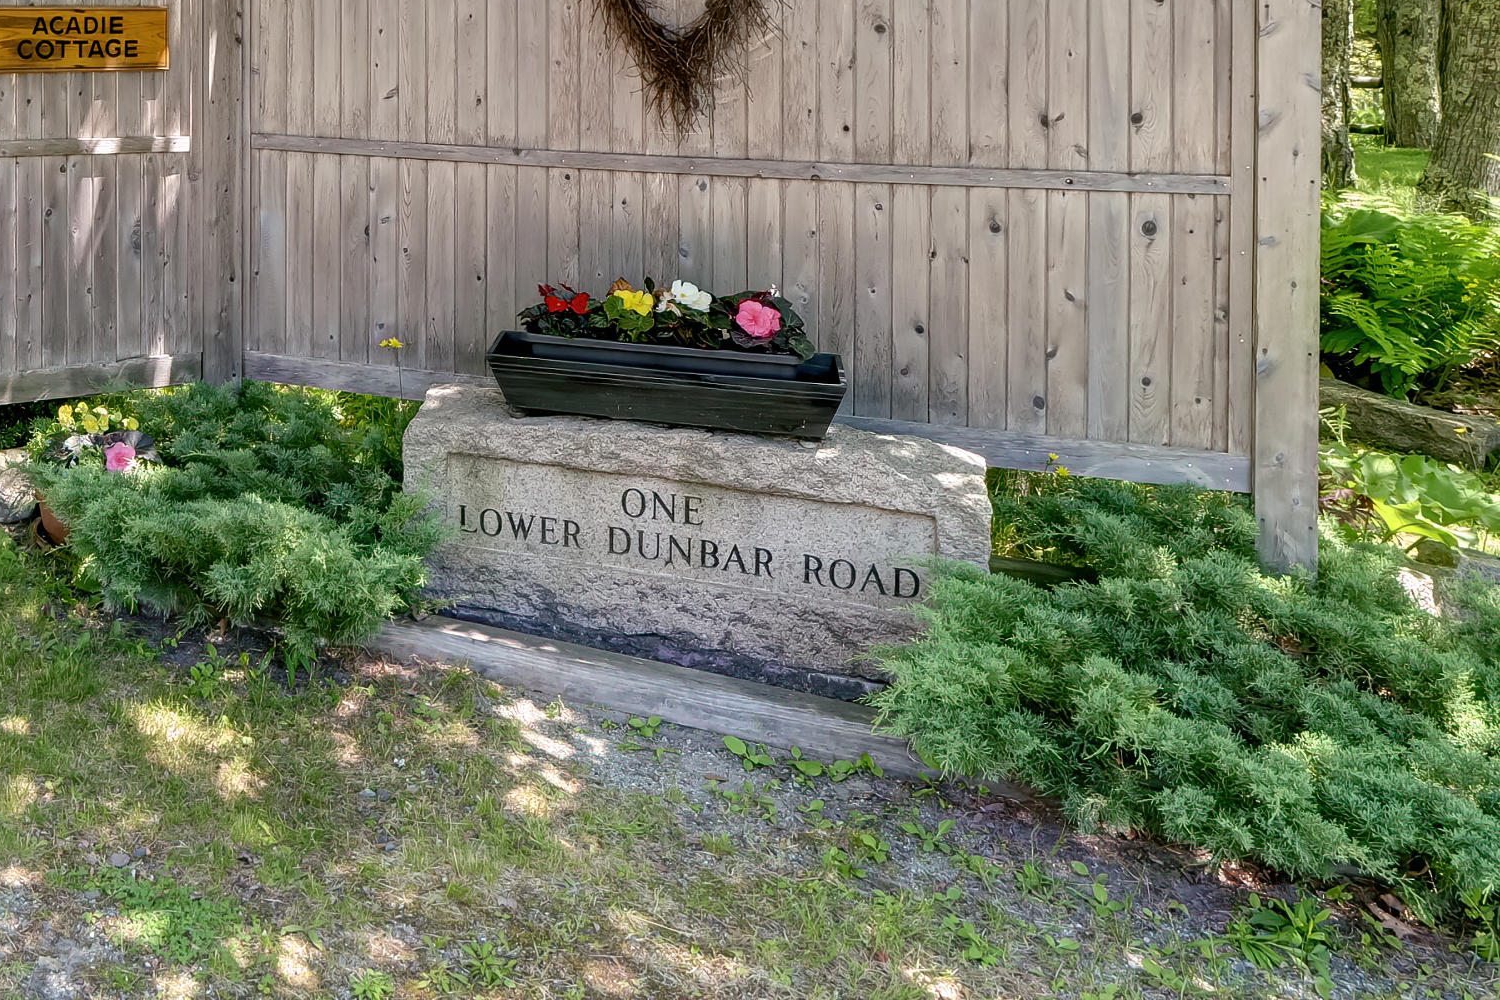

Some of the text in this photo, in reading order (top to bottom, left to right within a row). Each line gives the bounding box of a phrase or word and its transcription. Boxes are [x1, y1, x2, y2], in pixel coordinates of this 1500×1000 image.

[32, 16, 124, 35] ACADIE
[17, 39, 138, 59] COTTAGE
[621, 487, 704, 527] ONE
[458, 504, 921, 598] LOWER DUNBAR ROAD
